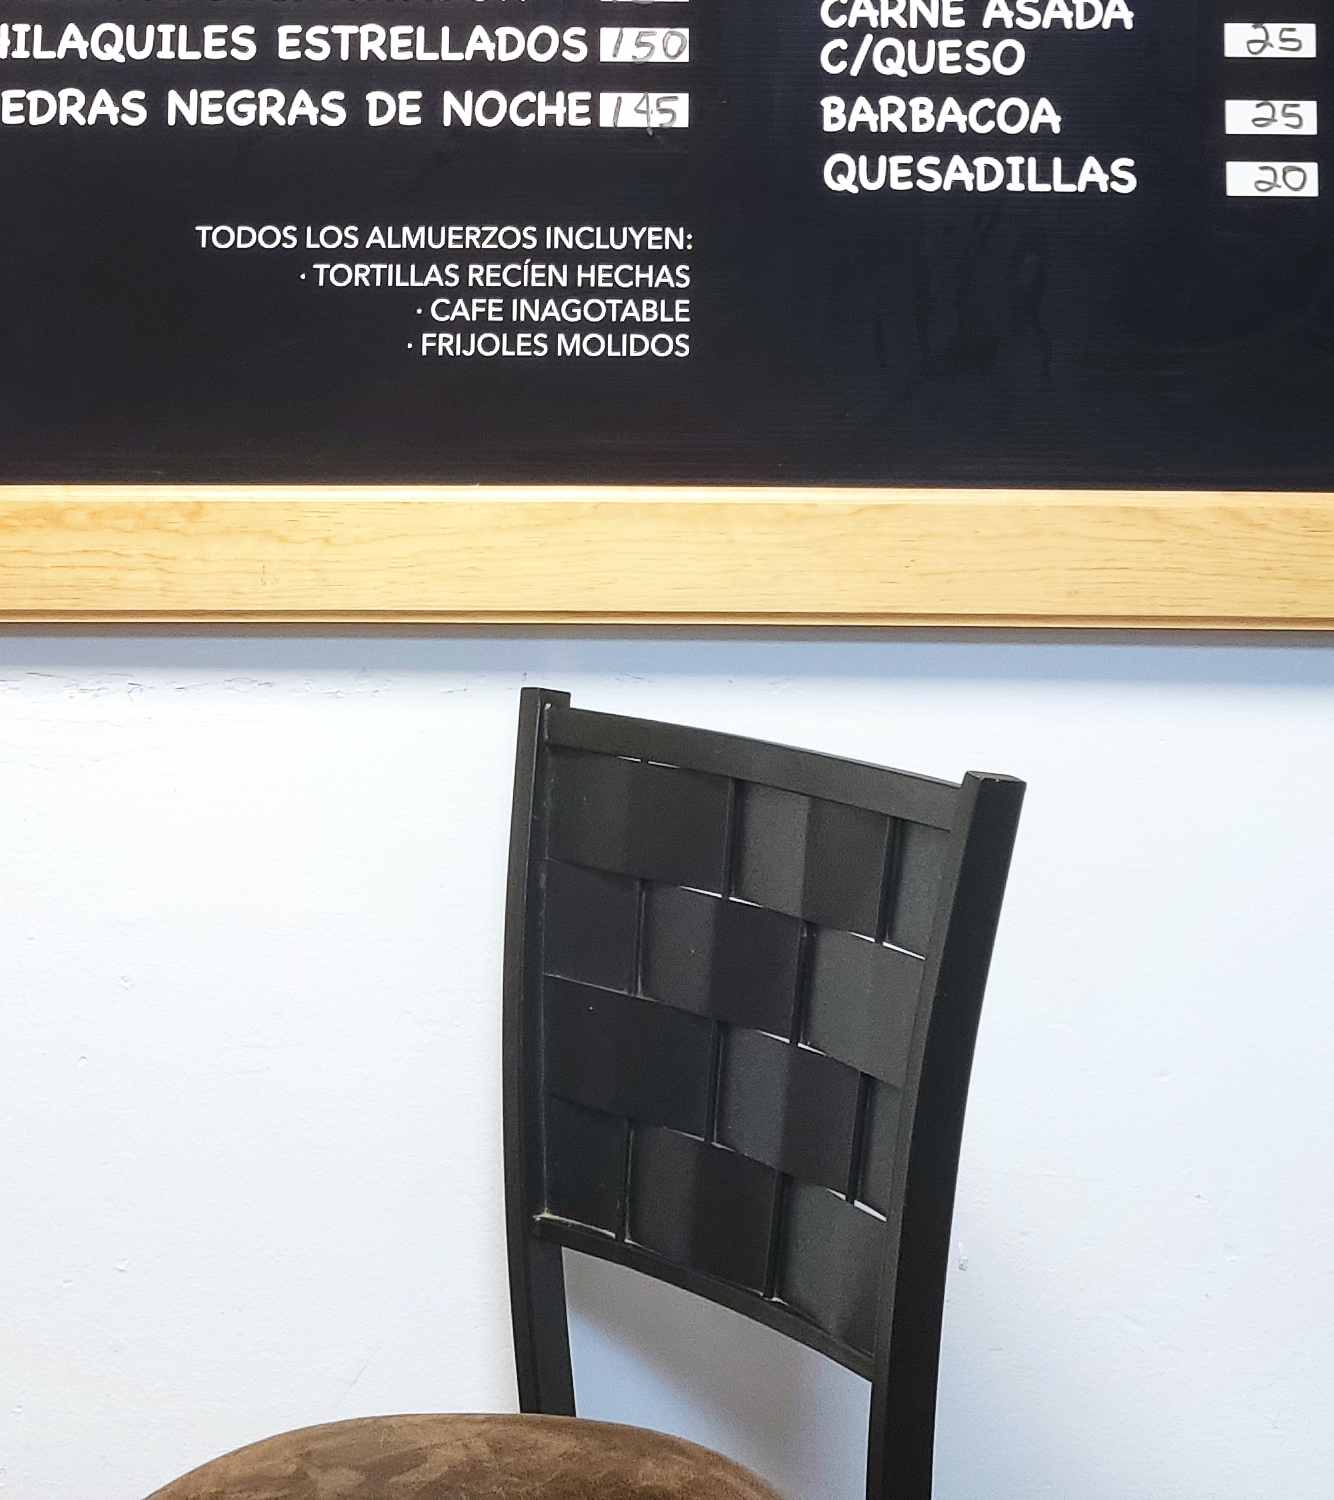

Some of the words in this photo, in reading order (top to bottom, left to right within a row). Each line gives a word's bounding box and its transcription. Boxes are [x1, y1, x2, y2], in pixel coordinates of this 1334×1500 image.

[278, 23, 587, 62] ESTRELLADOS
[612, 28, 687, 64] 150
[821, 34, 1025, 77] C/QUESO
[1246, 23, 1302, 55] 25
[168, 89, 346, 126] NEGRAS
[366, 91, 422, 126] DE
[444, 90, 591, 127] NOCHE
[612, 92, 679, 136] 145
[820, 96, 1061, 134] BARBACOA
[1251, 101, 1303, 129] 25
[824, 153, 1137, 193] QUESADILLAS
[1254, 165, 1307, 192] 20
[195, 226, 297, 248] TODOS
[307, 226, 358, 248] LOS
[366, 226, 537, 249] ALMUERZOS
[547, 227, 692, 249] INCLUYEN:
[313, 264, 459, 287] TORTILLAS
[469, 258, 567, 287] RECÍEN
[578, 265, 690, 288] HECHAS
[431, 299, 503, 321] CAFE
[513, 299, 690, 322] INAGOTABLE
[422, 333, 548, 356] FRIJOLES
[558, 334, 689, 357] MOLIDOS
